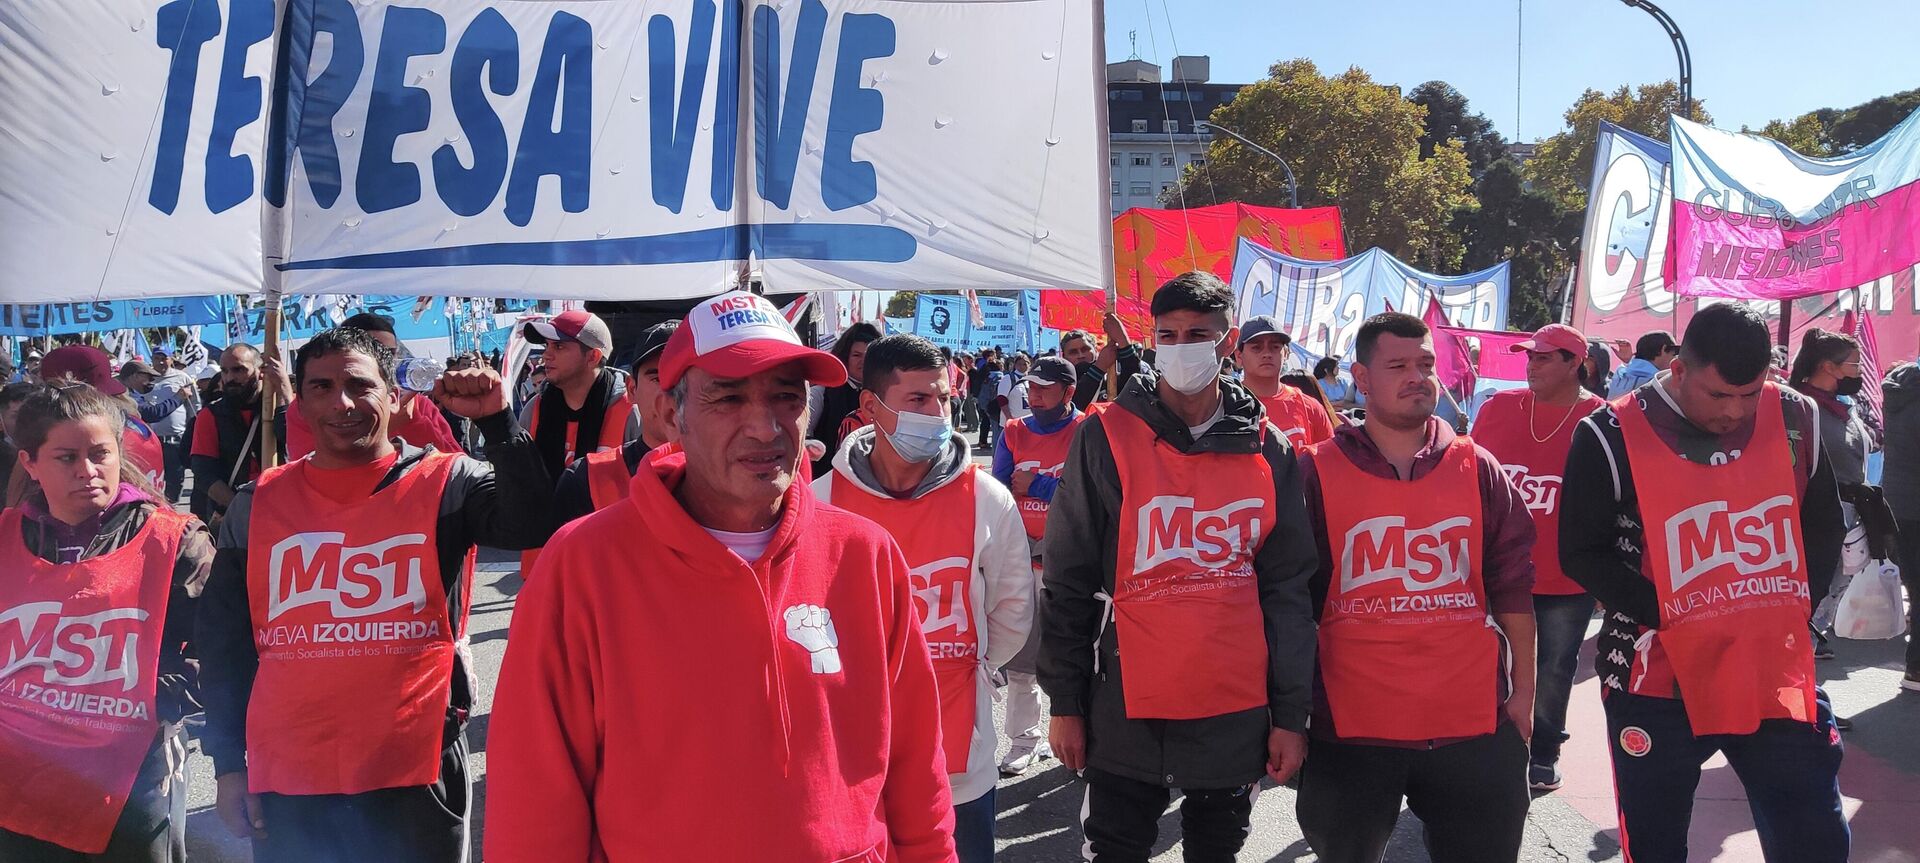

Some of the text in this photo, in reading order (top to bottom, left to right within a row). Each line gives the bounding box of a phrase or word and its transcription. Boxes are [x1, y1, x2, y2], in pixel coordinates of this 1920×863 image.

[148, 0, 898, 227] TERESA VIVE
[1695, 229, 1845, 281] MISIONES
[142, 305, 185, 317] LIBRES
[710, 296, 757, 317] MST
[718, 309, 772, 331] TERESA
[1145, 503, 1264, 563] MST
[1677, 508, 1797, 567] MST
[1350, 524, 1471, 584] MST
[278, 542, 426, 610] MST
[1170, 581, 1216, 596] Socialista
[1330, 597, 1387, 614] NUEVA
[1664, 586, 1728, 619] NUEVA
[0, 611, 140, 679] MST
[258, 619, 441, 648] NUEVA IZQUIERDA
[297, 647, 346, 661] Socialista
[348, 645, 362, 658] de
[364, 645, 381, 657] los
[18, 681, 150, 722] IZQUIERDA
[47, 711, 61, 722] de
[63, 714, 80, 728] los
